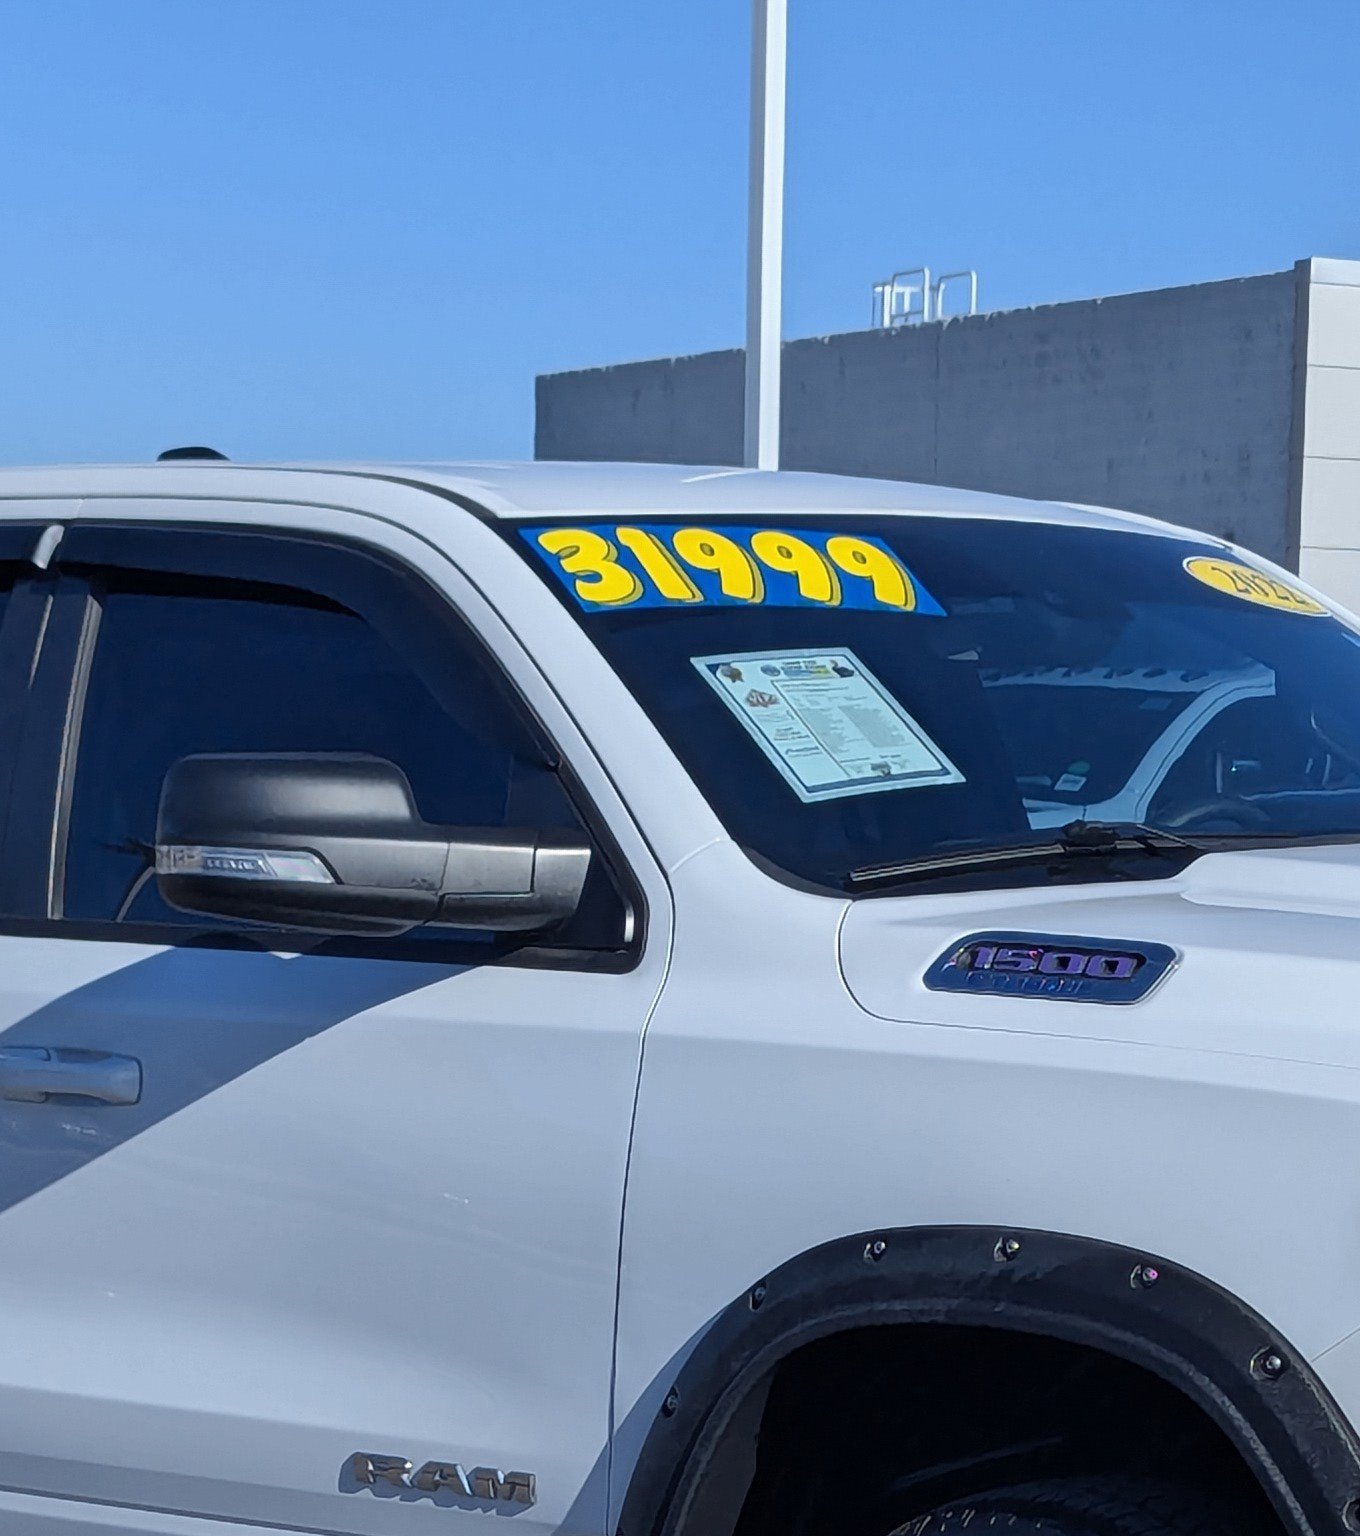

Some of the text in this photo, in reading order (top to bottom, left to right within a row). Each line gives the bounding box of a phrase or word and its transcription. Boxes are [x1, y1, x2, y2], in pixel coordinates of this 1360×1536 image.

[537, 526, 916, 611] 31999
[974, 946, 1139, 978] 1500
[348, 1451, 537, 1507] RAM
